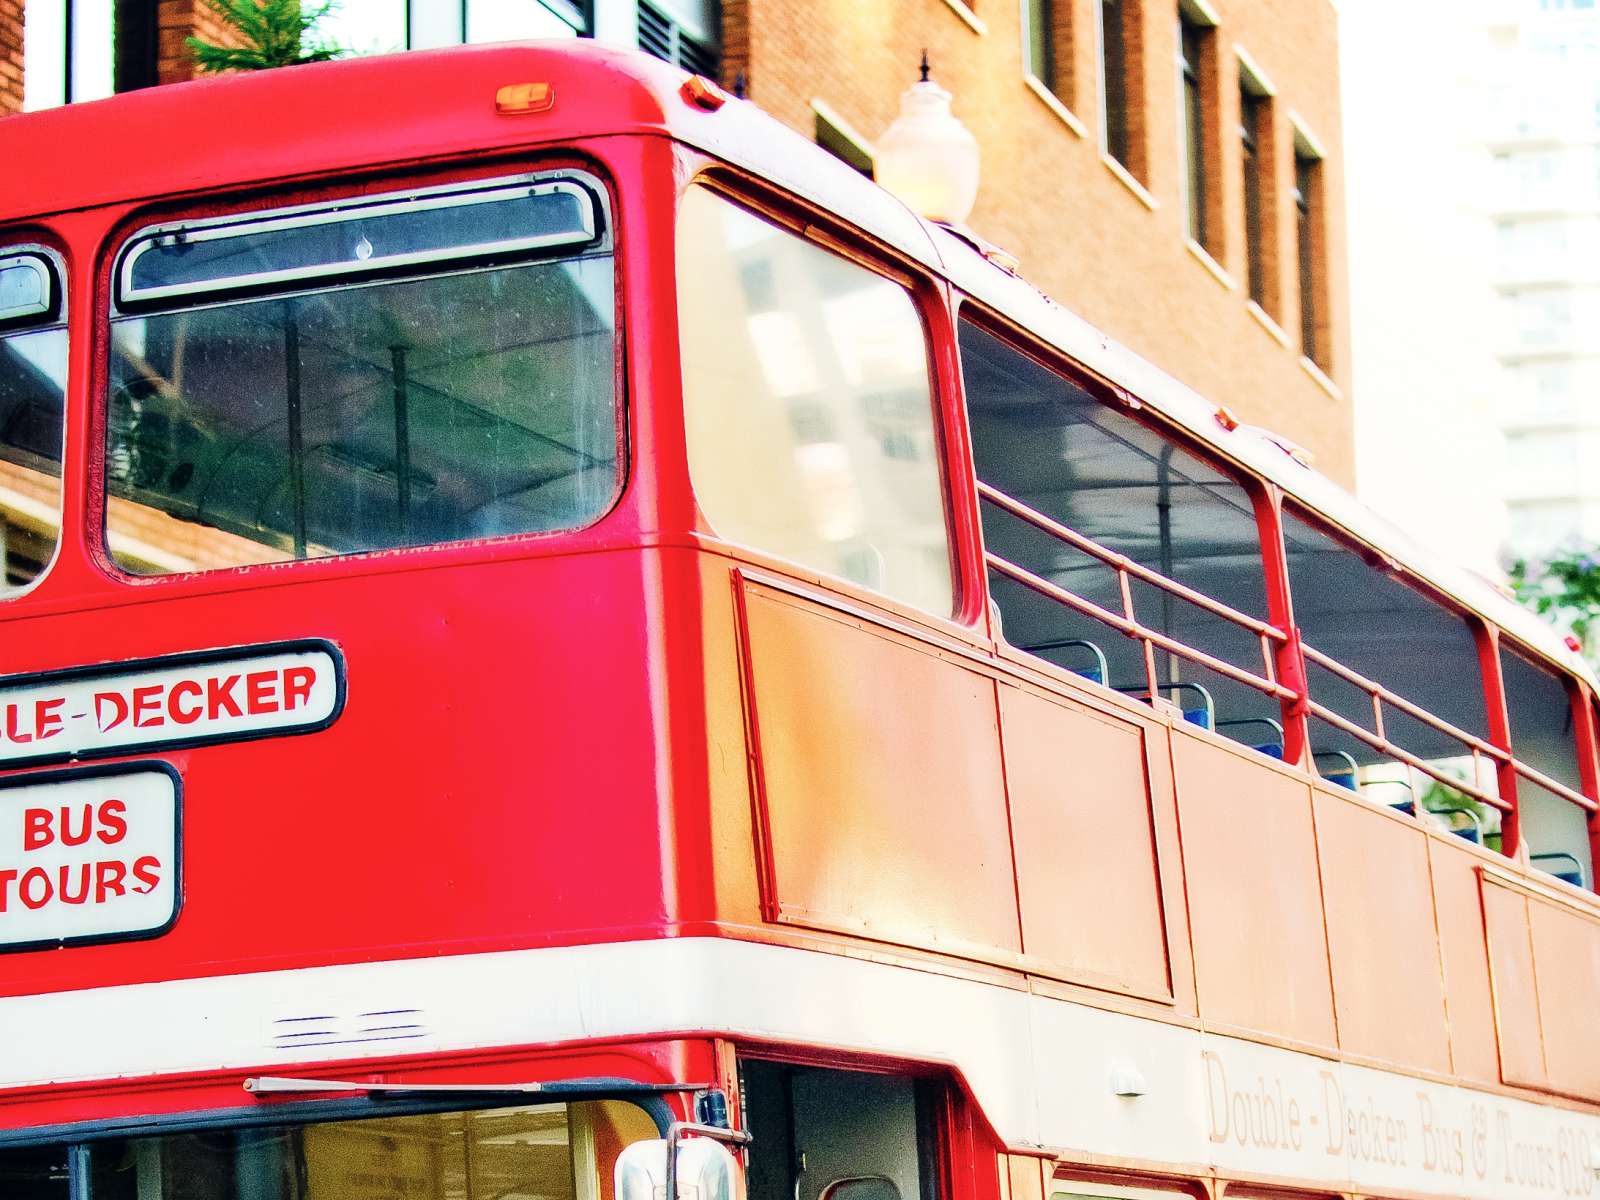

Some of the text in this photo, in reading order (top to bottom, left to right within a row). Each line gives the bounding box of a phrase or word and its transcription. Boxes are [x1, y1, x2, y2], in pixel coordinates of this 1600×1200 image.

[0, 665, 317, 744] LE-DECKER
[24, 799, 127, 851] BUS
[0, 855, 161, 912] TOURS
[1417, 1091, 1464, 1176] Bus
[1496, 1108, 1556, 1190] Tours
